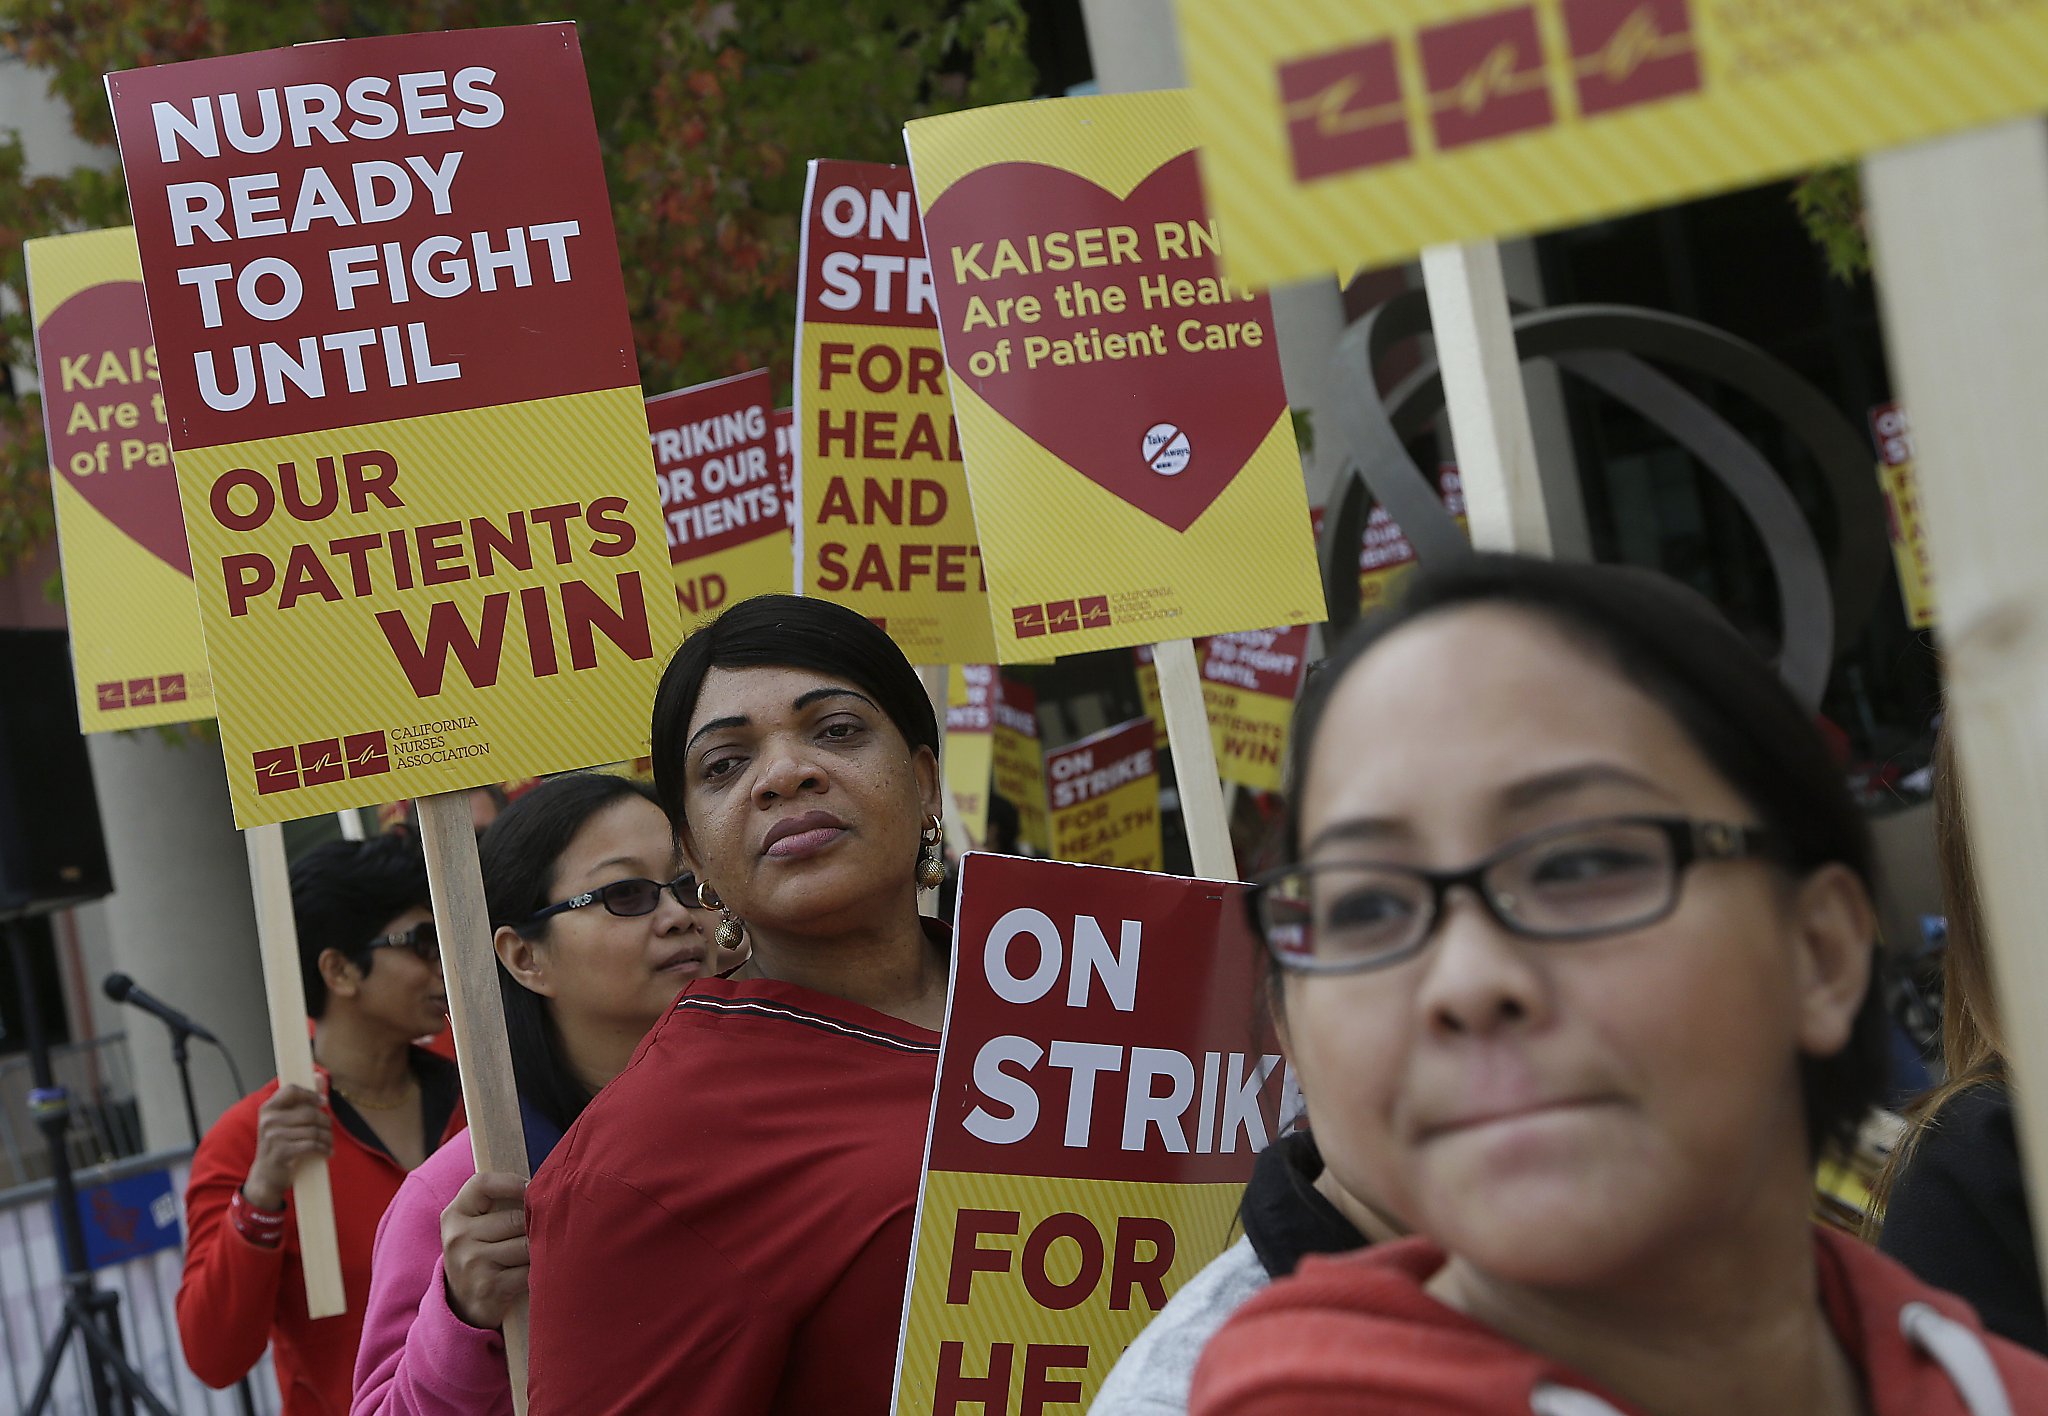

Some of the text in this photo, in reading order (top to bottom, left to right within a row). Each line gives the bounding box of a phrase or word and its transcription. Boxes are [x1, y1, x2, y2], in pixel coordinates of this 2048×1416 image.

[151, 67, 504, 163] NURSES
[166, 152, 463, 246] READY
[820, 185, 910, 241] ON
[178, 220, 580, 328] TO FIGHT
[951, 226, 1141, 284] KAISER
[962, 293, 1042, 333] Are
[1055, 281, 1127, 318] the
[193, 321, 461, 412] UNTIL
[818, 343, 943, 396] FOR
[969, 319, 1263, 378] of Patient Care
[66, 401, 140, 435] Are
[651, 405, 766, 465] RIKING
[70, 439, 173, 477] of Pa
[701, 447, 768, 494] OUR
[210, 449, 405, 531] OUR
[816, 476, 948, 526] AND
[222, 497, 637, 617] PATIENTS
[375, 571, 653, 698] WIN
[391, 716, 479, 741] CALIFORNIA
[393, 736, 446, 755] NURSES
[396, 743, 490, 770] ASSOCIATION
[1052, 750, 1094, 781] ON
[1054, 749, 1152, 807] STRIKE
[983, 907, 1142, 1012] ON
[946, 1209, 1176, 1311] FOR
[932, 1341, 1128, 1416] HE
